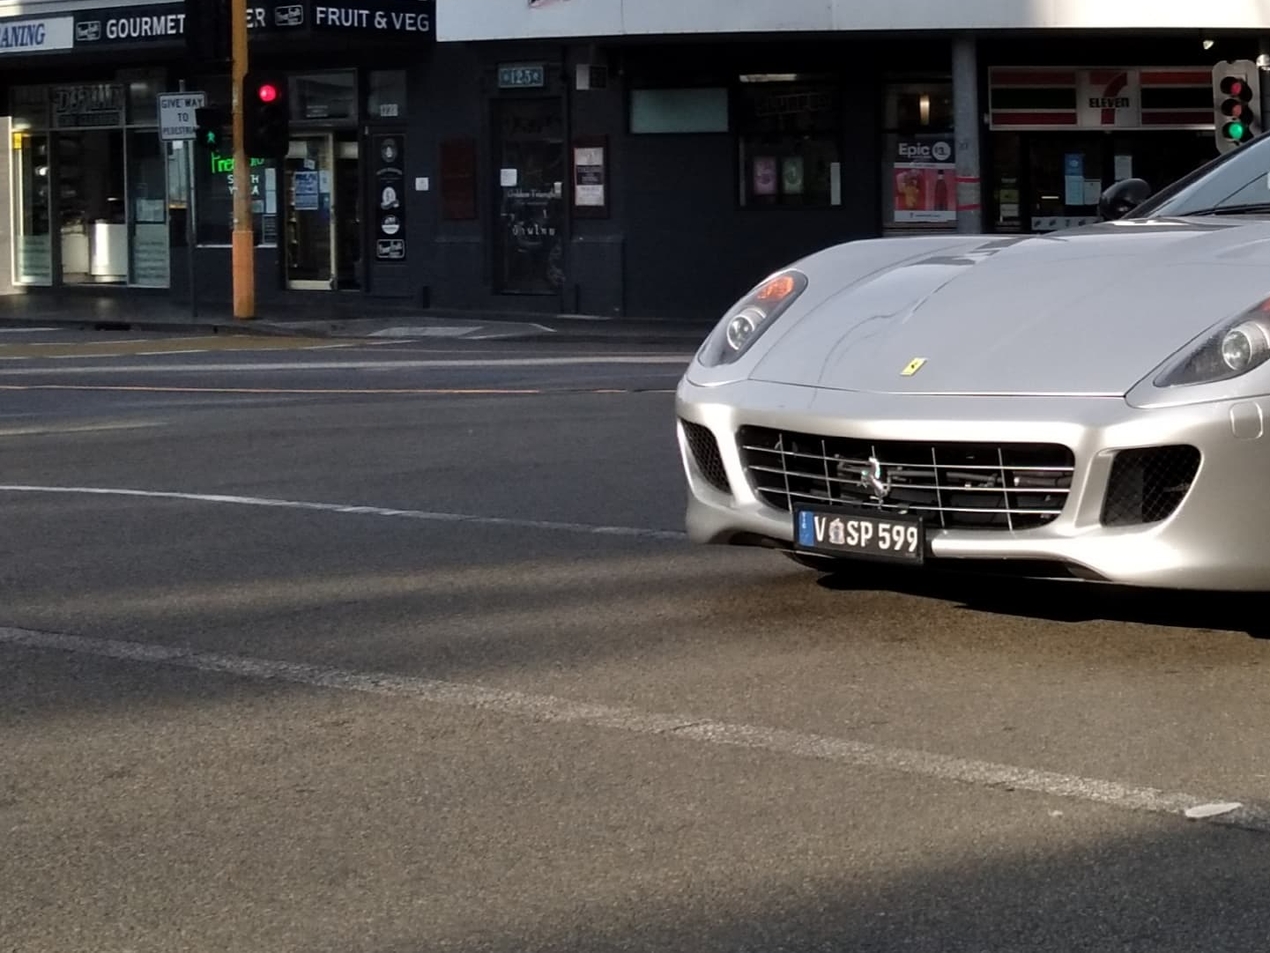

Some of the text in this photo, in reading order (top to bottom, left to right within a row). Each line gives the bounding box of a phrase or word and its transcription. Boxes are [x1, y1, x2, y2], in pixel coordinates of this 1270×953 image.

[106, 14, 186, 40] GOURMET
[316, 6, 370, 27] FRUIT
[374, 11, 387, 29] &
[391, 12, 429, 32] VEG
[0, 23, 46, 48] ANING
[161, 98, 203, 109] GIVE WAY
[1090, 71, 1127, 125] 7
[177, 112, 189, 122] TO
[898, 141, 931, 158] Epic
[878, 523, 918, 552] 599
